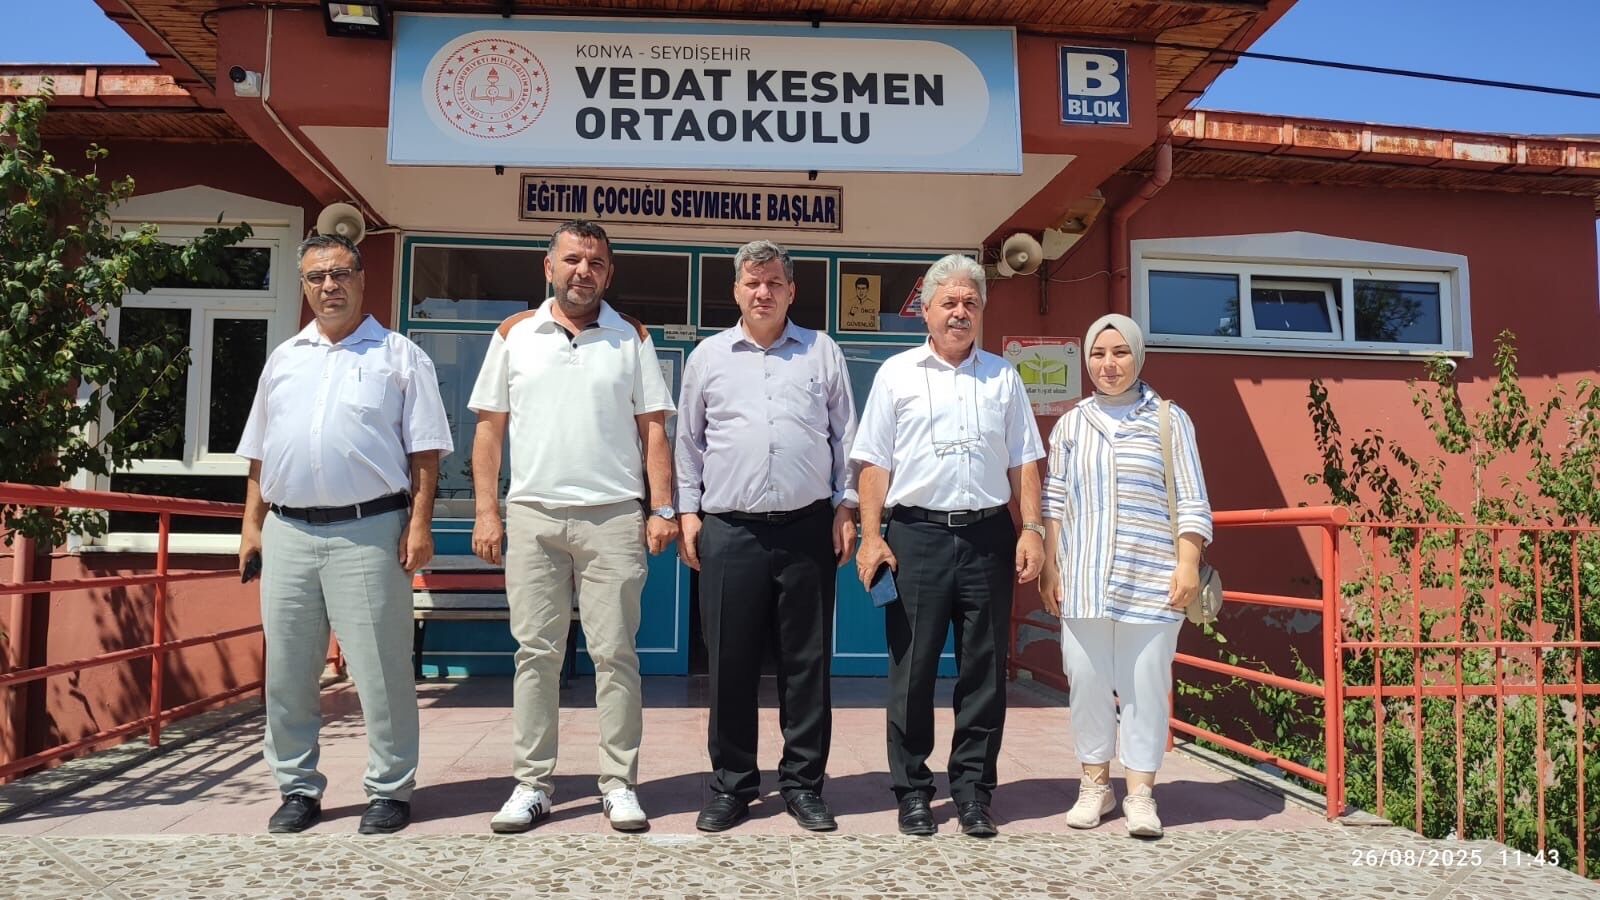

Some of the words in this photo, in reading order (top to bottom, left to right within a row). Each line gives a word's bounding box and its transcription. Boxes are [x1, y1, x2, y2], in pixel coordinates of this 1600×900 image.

[576, 44, 633, 59] KONYA
[650, 43, 751, 64] SEYDİŞEHİR
[575, 66, 732, 101] VEDAT
[747, 69, 944, 106] KESMEN
[1066, 52, 1121, 97] B
[575, 106, 870, 145] ORTAOKULU
[1067, 98, 1121, 118] BLOK
[593, 183, 666, 218] ÇOCUĞU
[671, 188, 761, 221] SEVMEKLE
[766, 193, 836, 226] BAŞLAR
